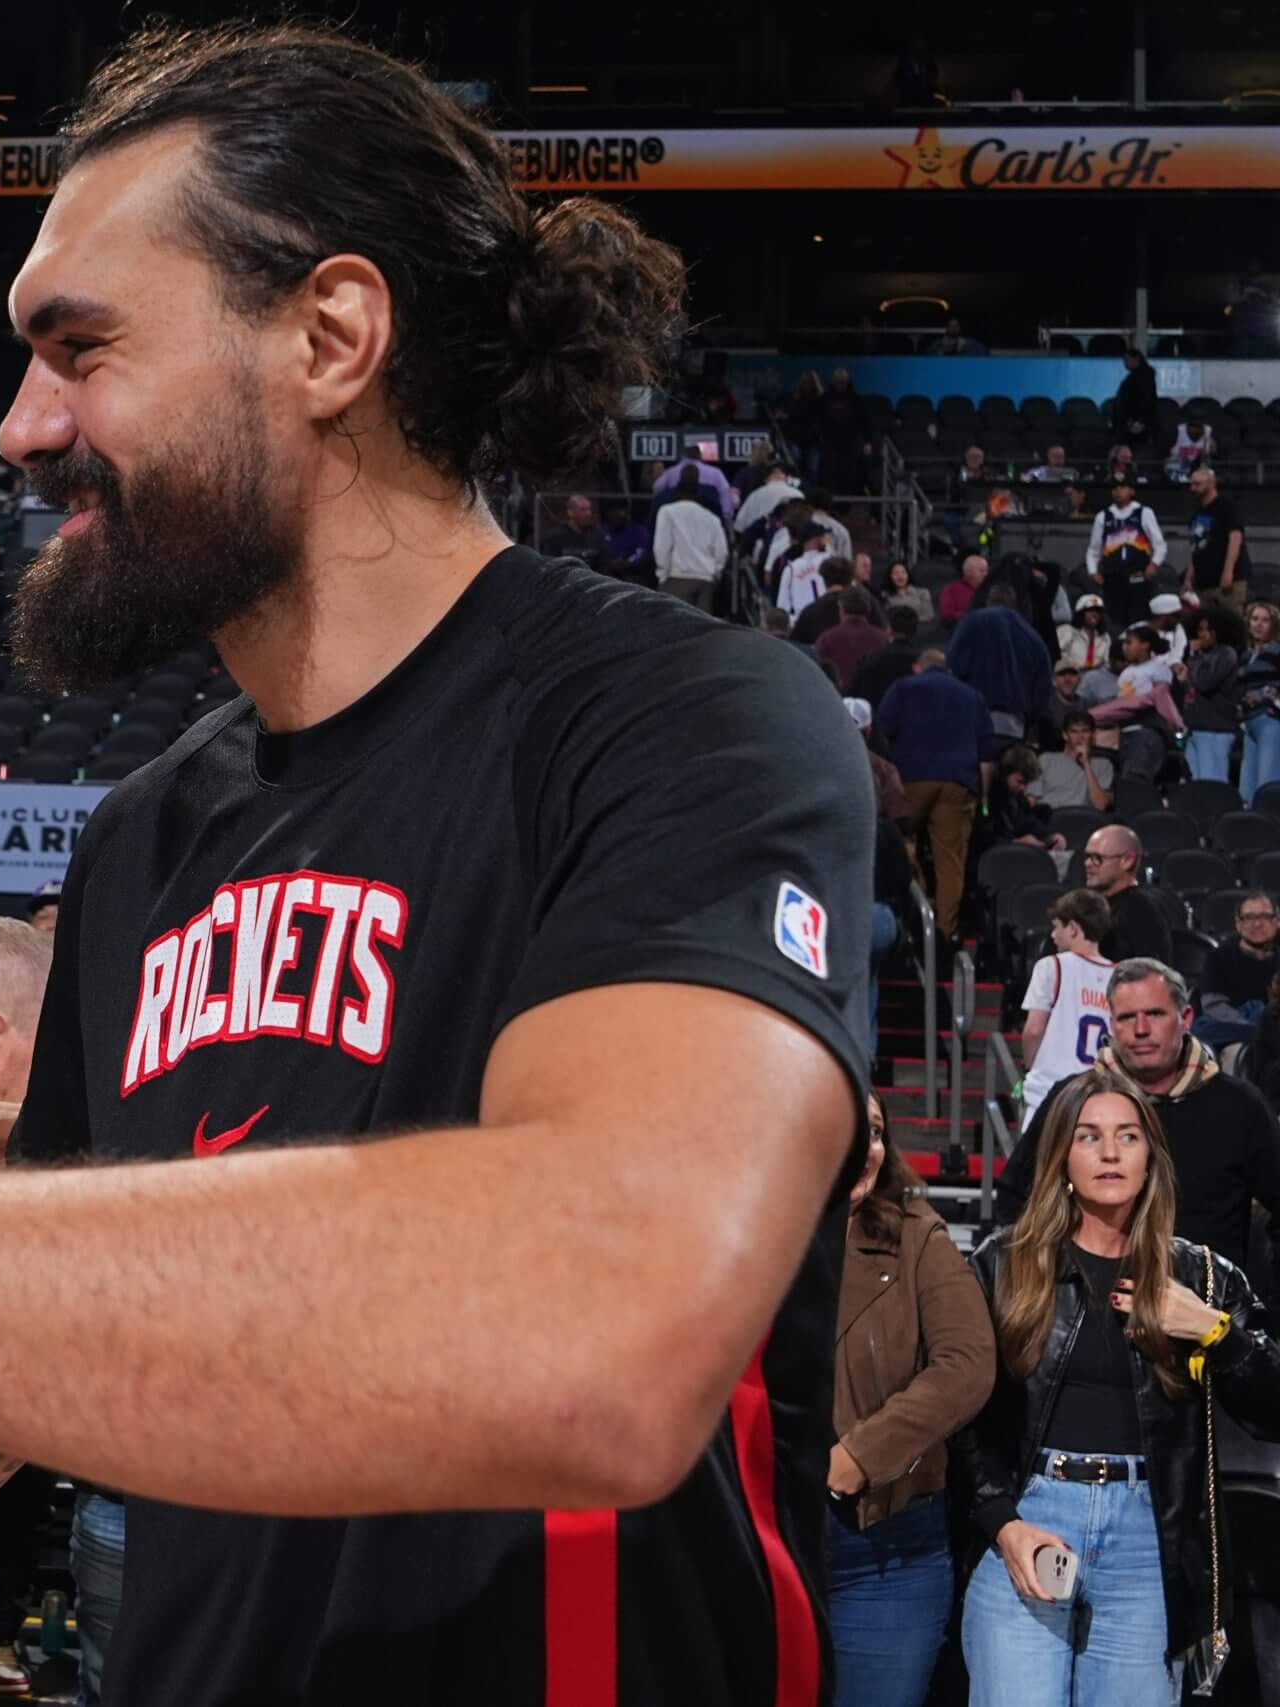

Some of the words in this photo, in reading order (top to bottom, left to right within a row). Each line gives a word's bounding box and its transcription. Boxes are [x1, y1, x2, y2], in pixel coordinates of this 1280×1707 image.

[960, 136, 1096, 191] Carl's
[1101, 137, 1172, 191] Jr.
[639, 437, 668, 455] 101
[10, 807, 90, 823] CLUB
[120, 868, 409, 1099] ROCKETS
[1081, 986, 1109, 1009] DUN
